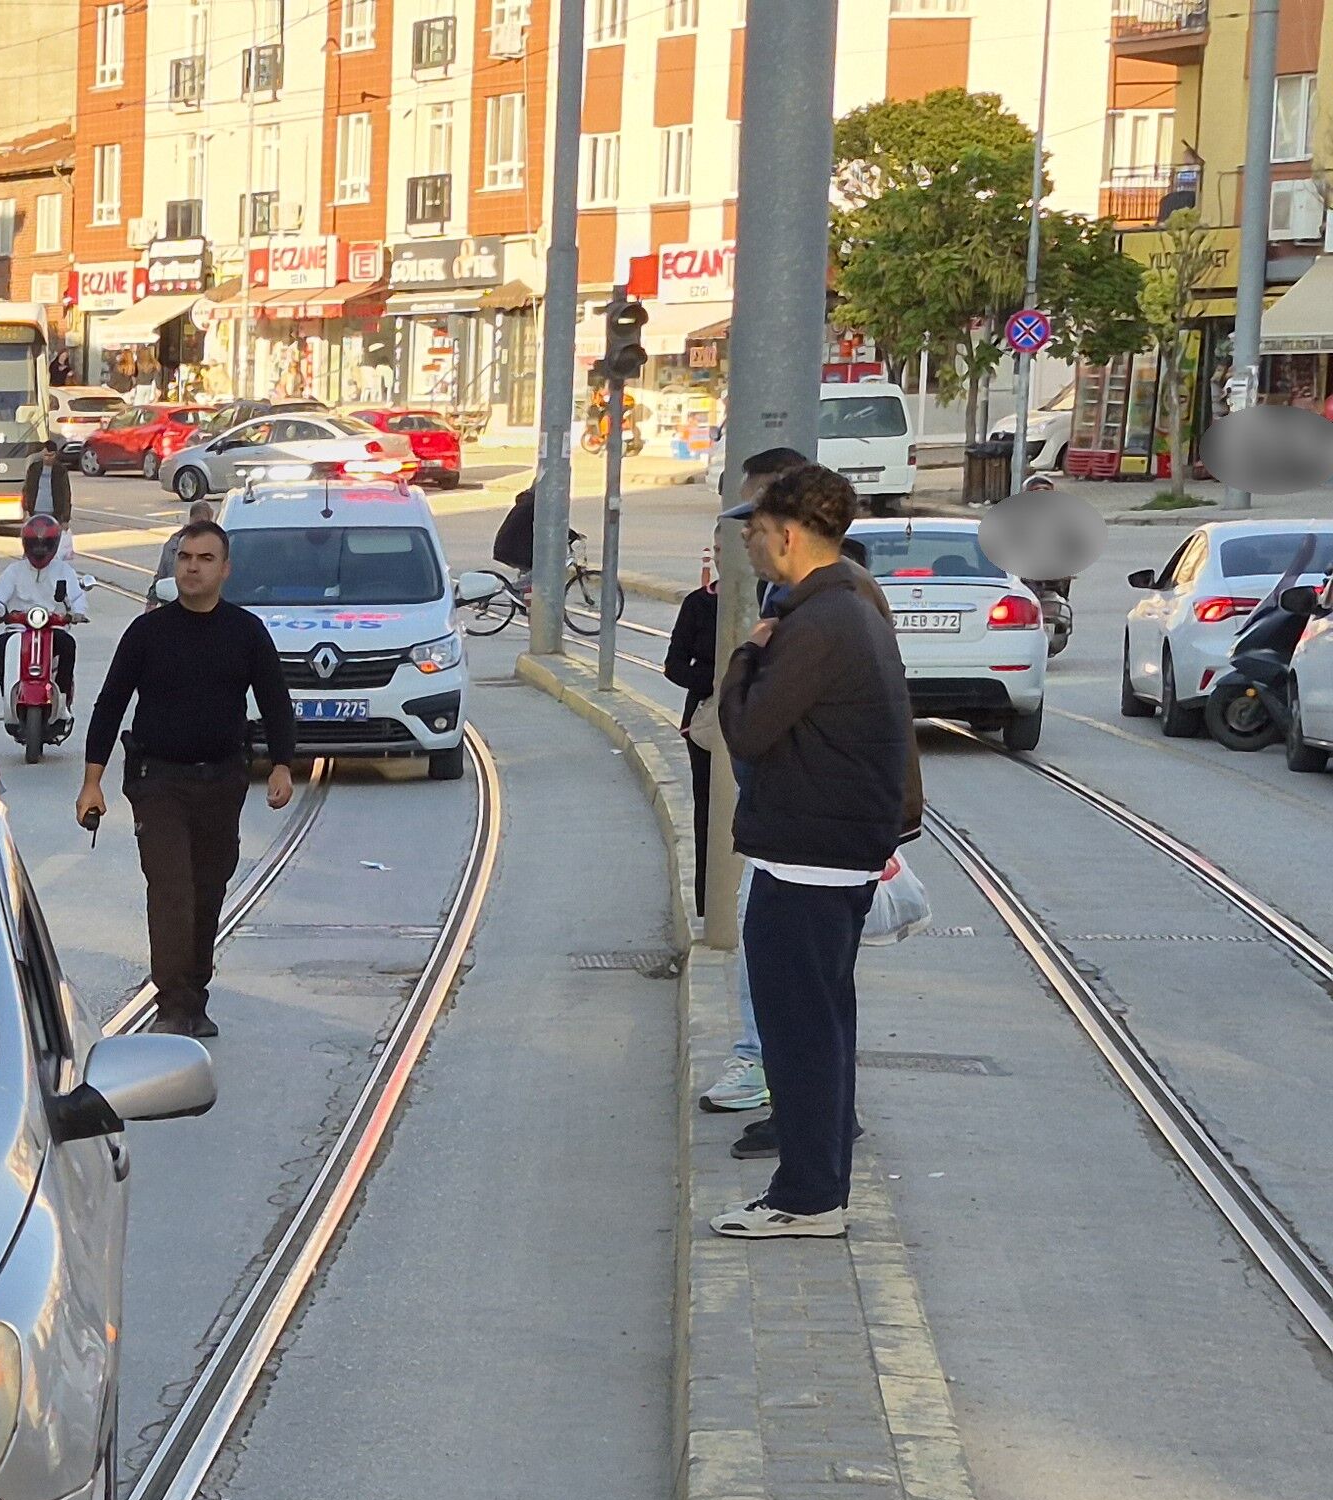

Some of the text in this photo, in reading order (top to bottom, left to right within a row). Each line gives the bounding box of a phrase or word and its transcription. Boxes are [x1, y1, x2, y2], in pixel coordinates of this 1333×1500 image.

[271, 245, 326, 271] ECZANE
[82, 271, 128, 295] ECZANE
[933, 615, 957, 627] 372
[315, 702, 323, 716] A
[335, 701, 367, 717] 7275
